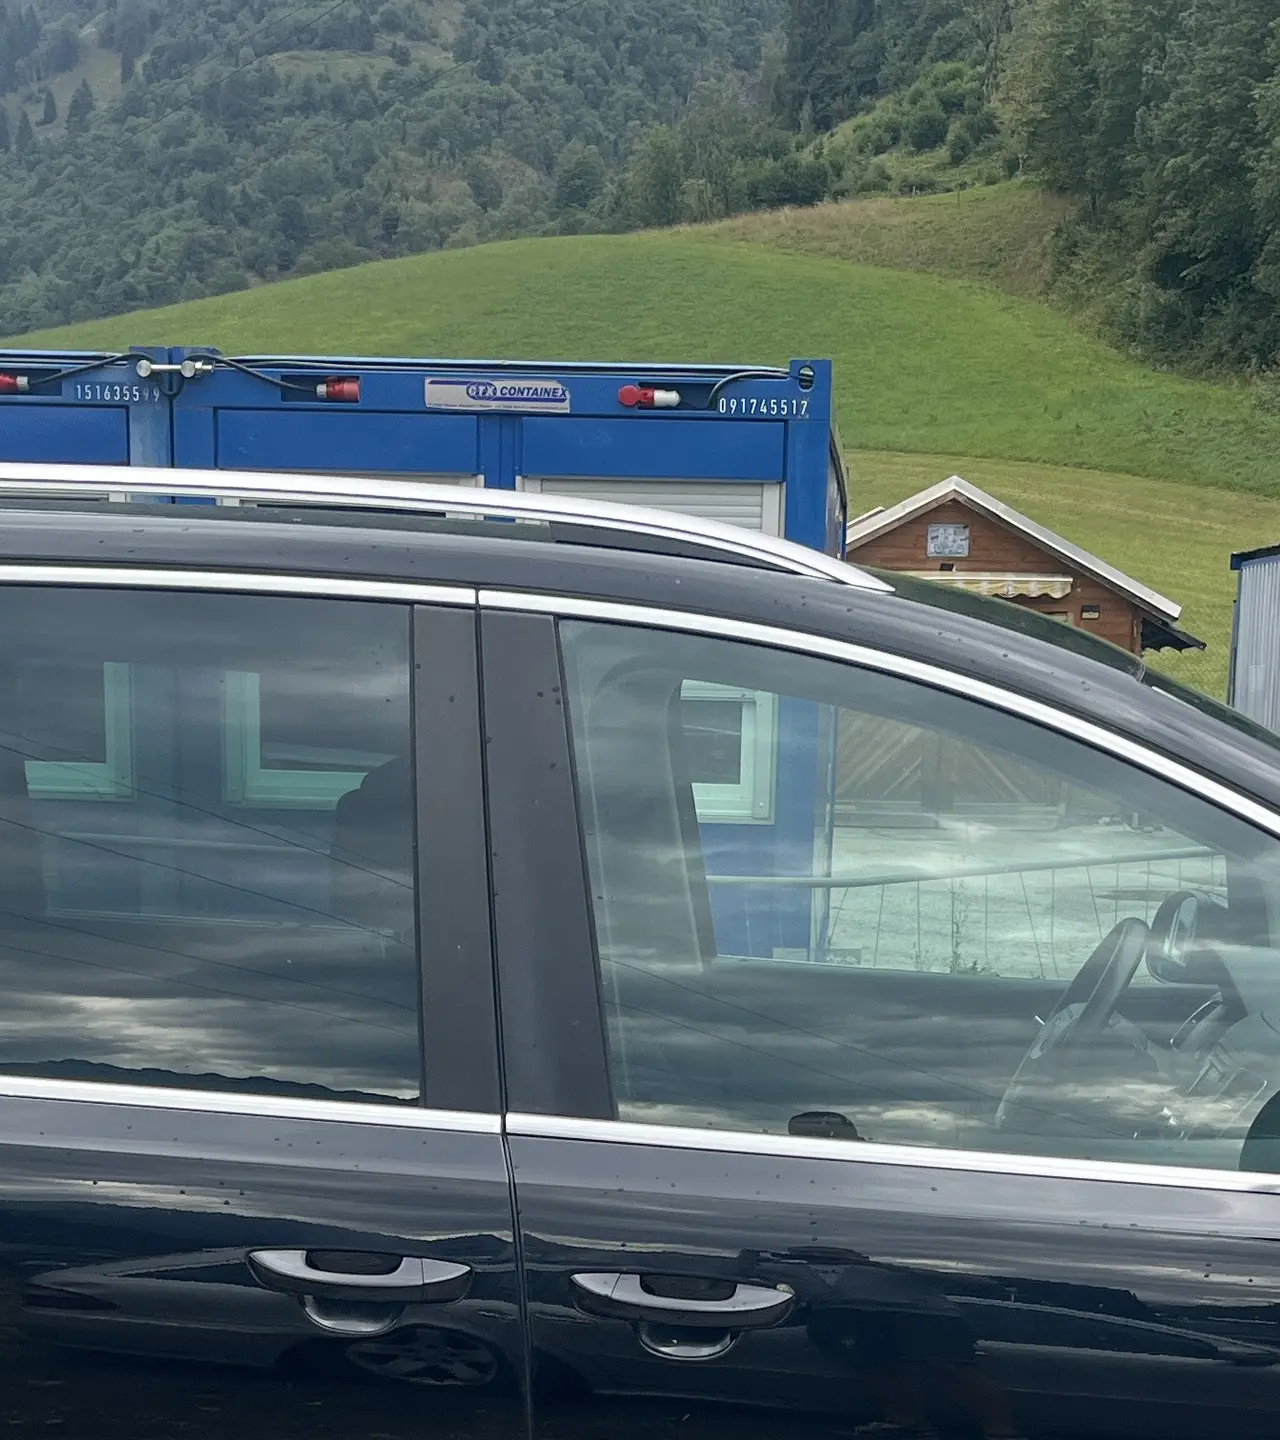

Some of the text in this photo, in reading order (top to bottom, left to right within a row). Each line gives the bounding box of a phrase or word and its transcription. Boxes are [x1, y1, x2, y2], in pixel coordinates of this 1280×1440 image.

[76, 384, 160, 402] 151635599
[467, 383, 568, 400] CTX CONTAINEX
[719, 398, 808, 415] 091745517
